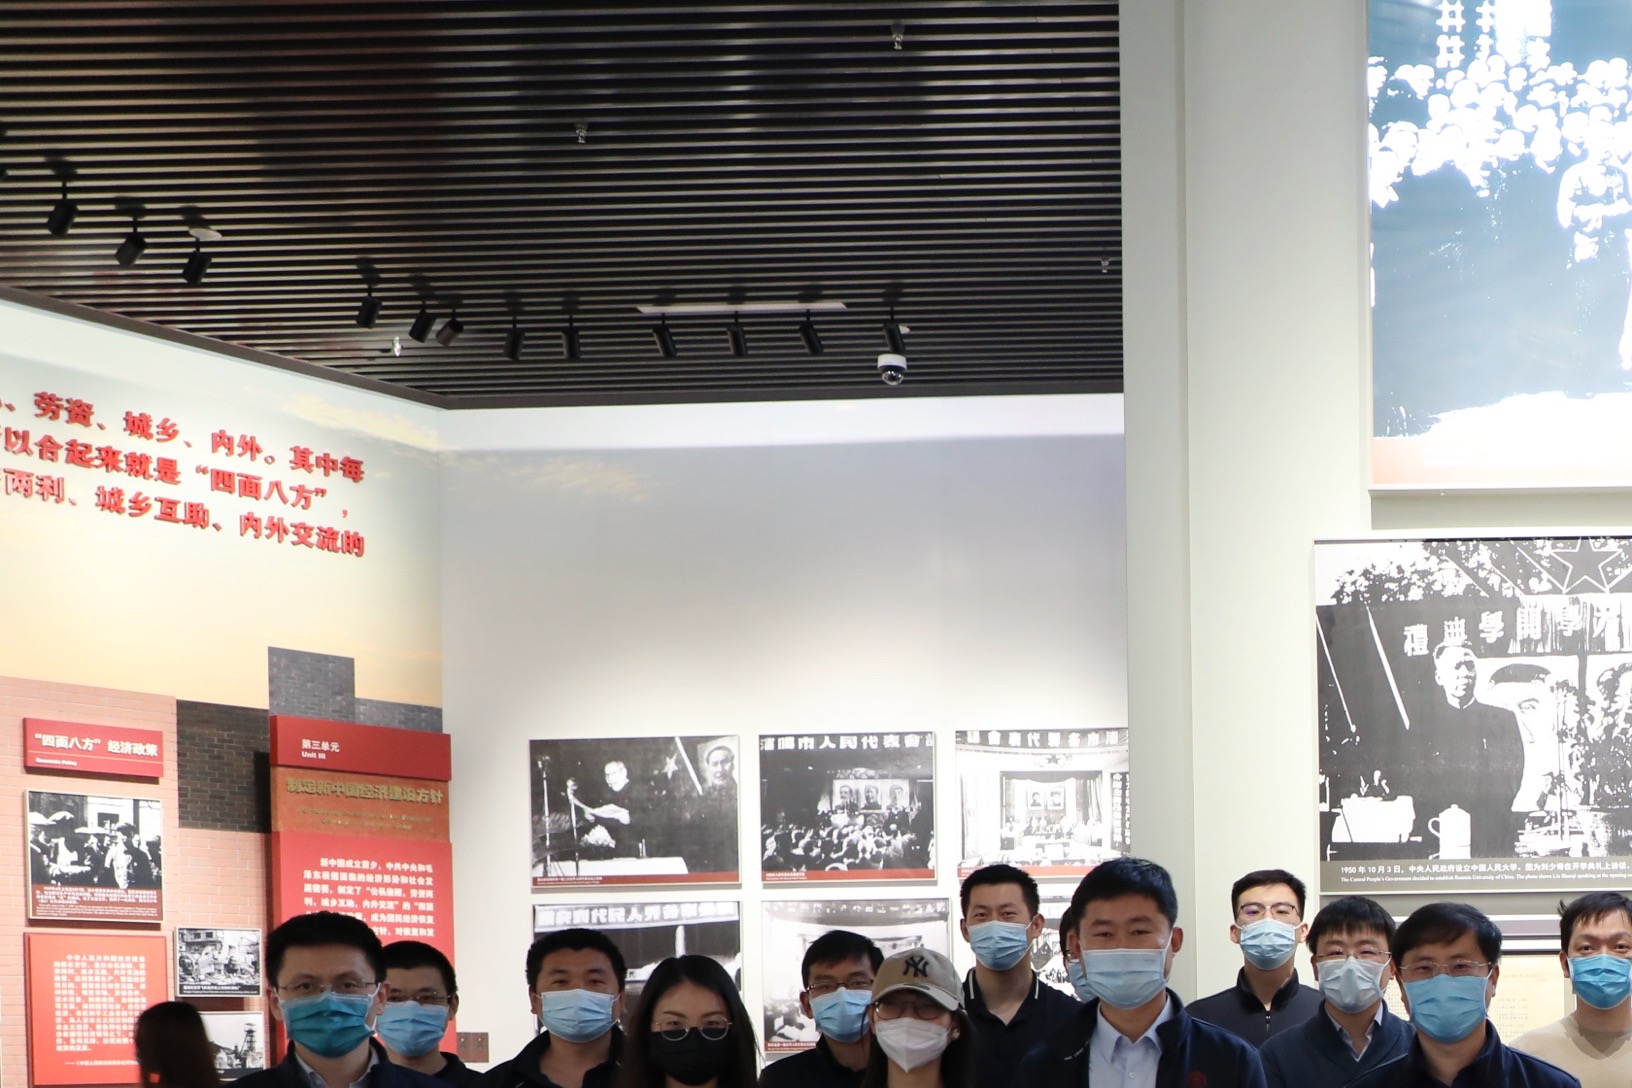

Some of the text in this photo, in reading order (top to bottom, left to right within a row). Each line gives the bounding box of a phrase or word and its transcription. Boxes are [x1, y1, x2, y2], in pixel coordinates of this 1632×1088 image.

[0, 391, 365, 483] 、劳资、城乡、内外。其中每
[0, 425, 348, 518] 以合起来就是“四面八方”，
[0, 467, 365, 557] 两利、城乡互助、内外交流的
[302, 738, 340, 752] 第三单元
[1341, 866, 1356, 874] 1950
